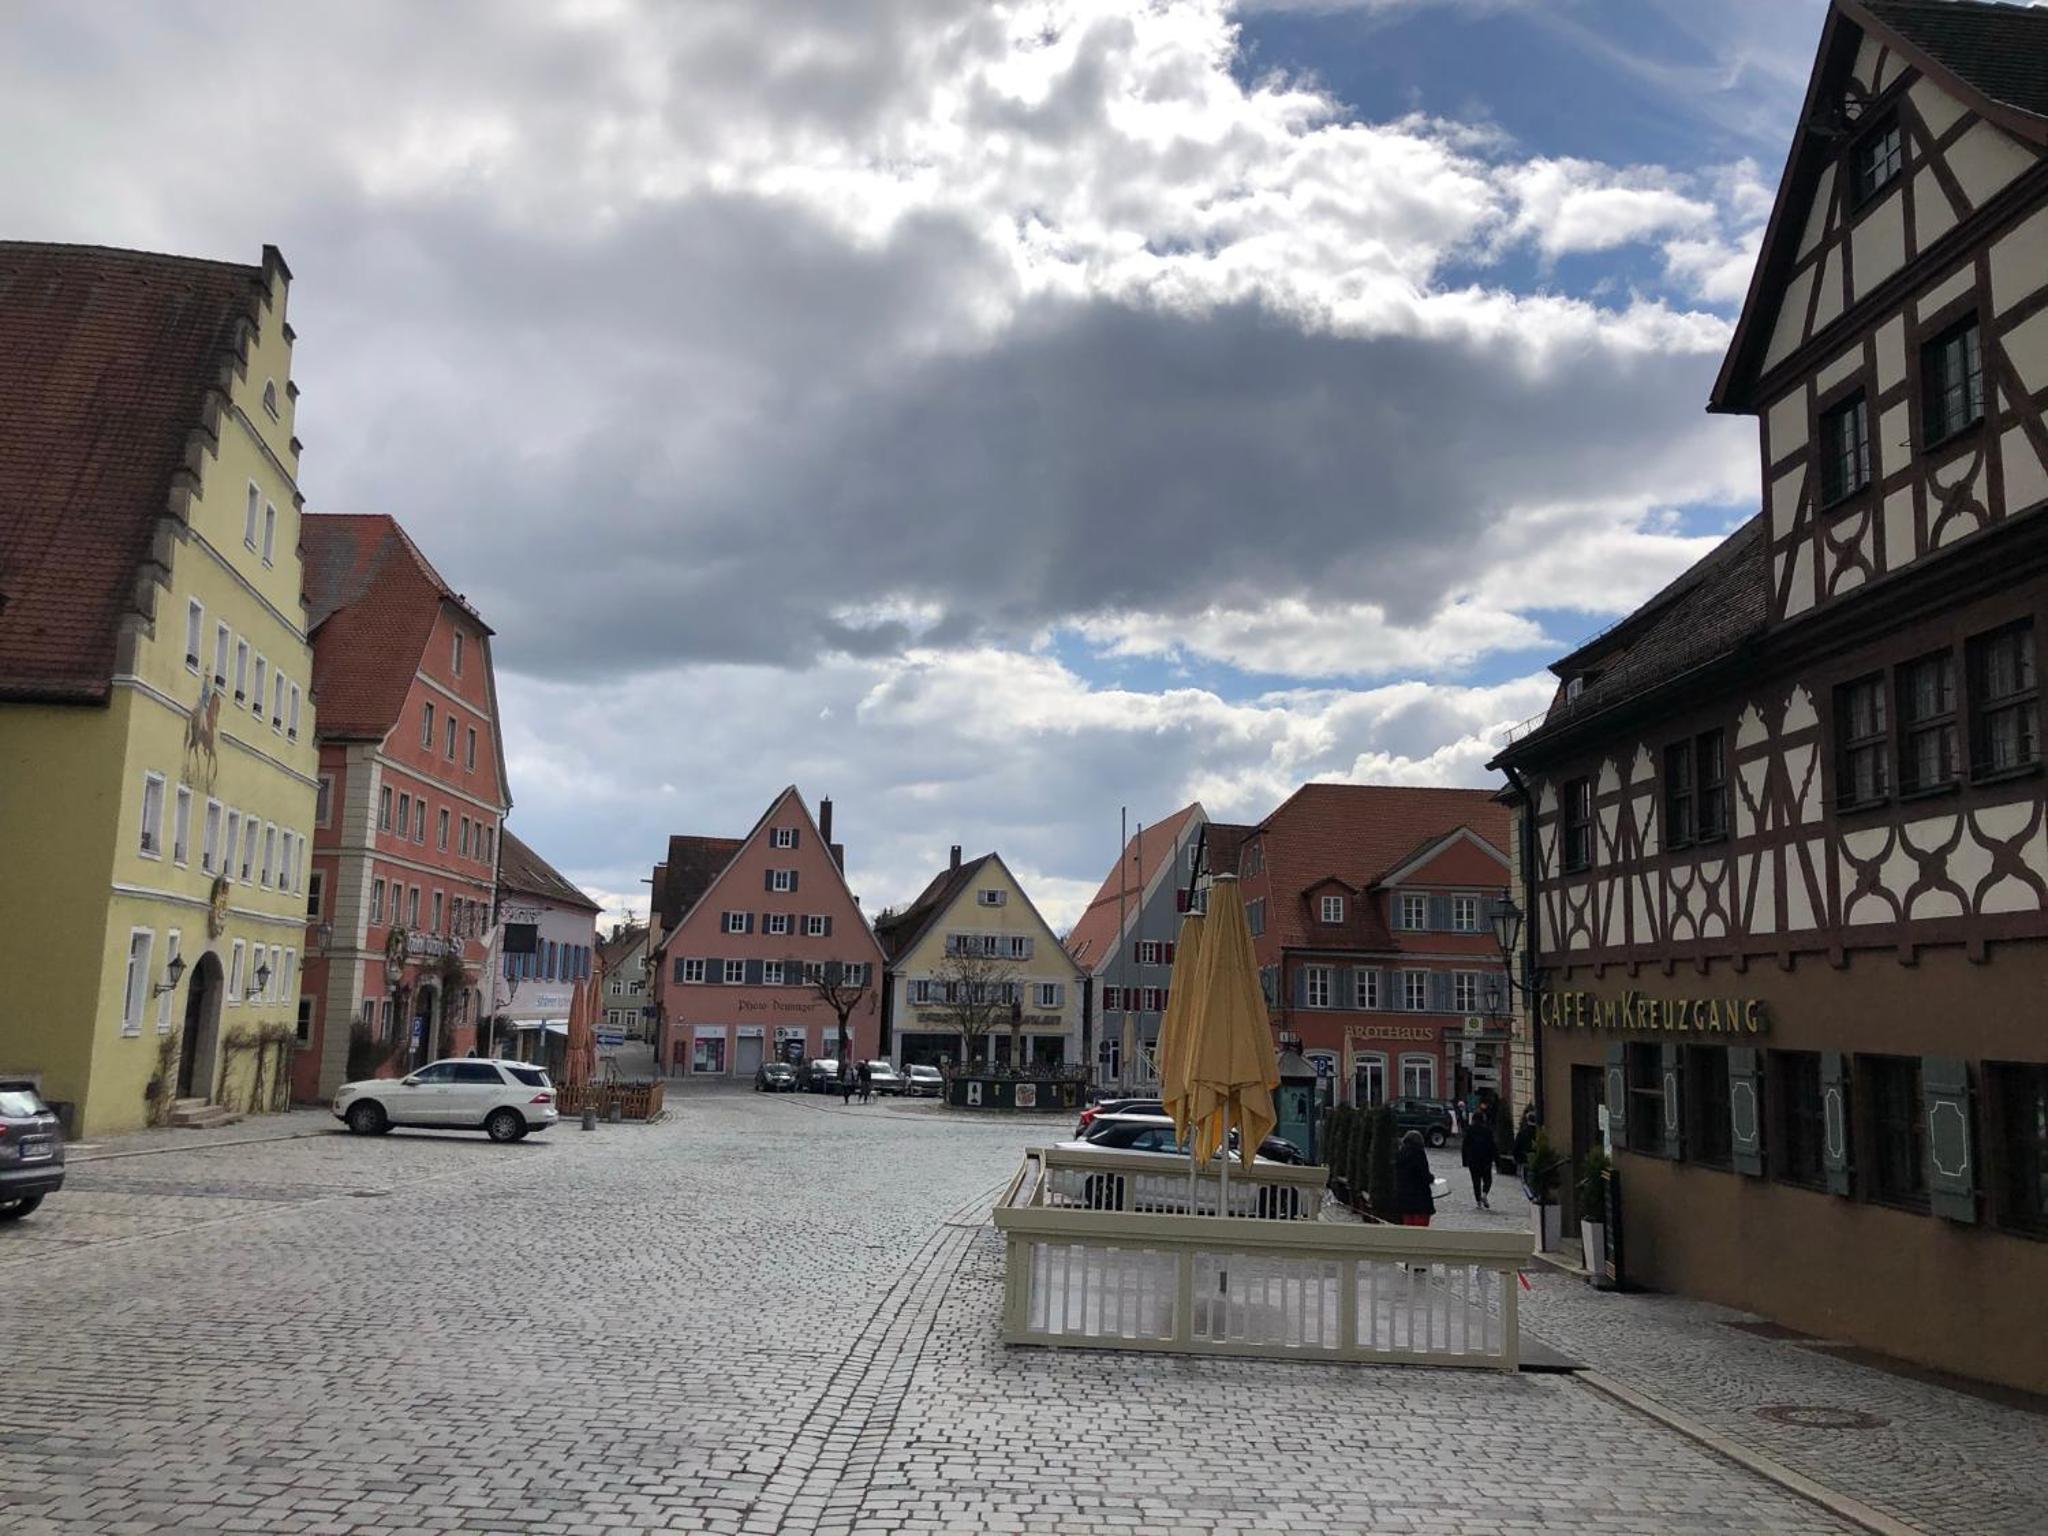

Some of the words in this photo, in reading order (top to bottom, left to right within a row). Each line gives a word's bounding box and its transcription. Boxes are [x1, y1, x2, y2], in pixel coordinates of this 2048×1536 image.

[1540, 991, 1584, 1027] CAFE
[1592, 1000, 1616, 1028] AM
[1622, 990, 1759, 1032] KREUZGANG
